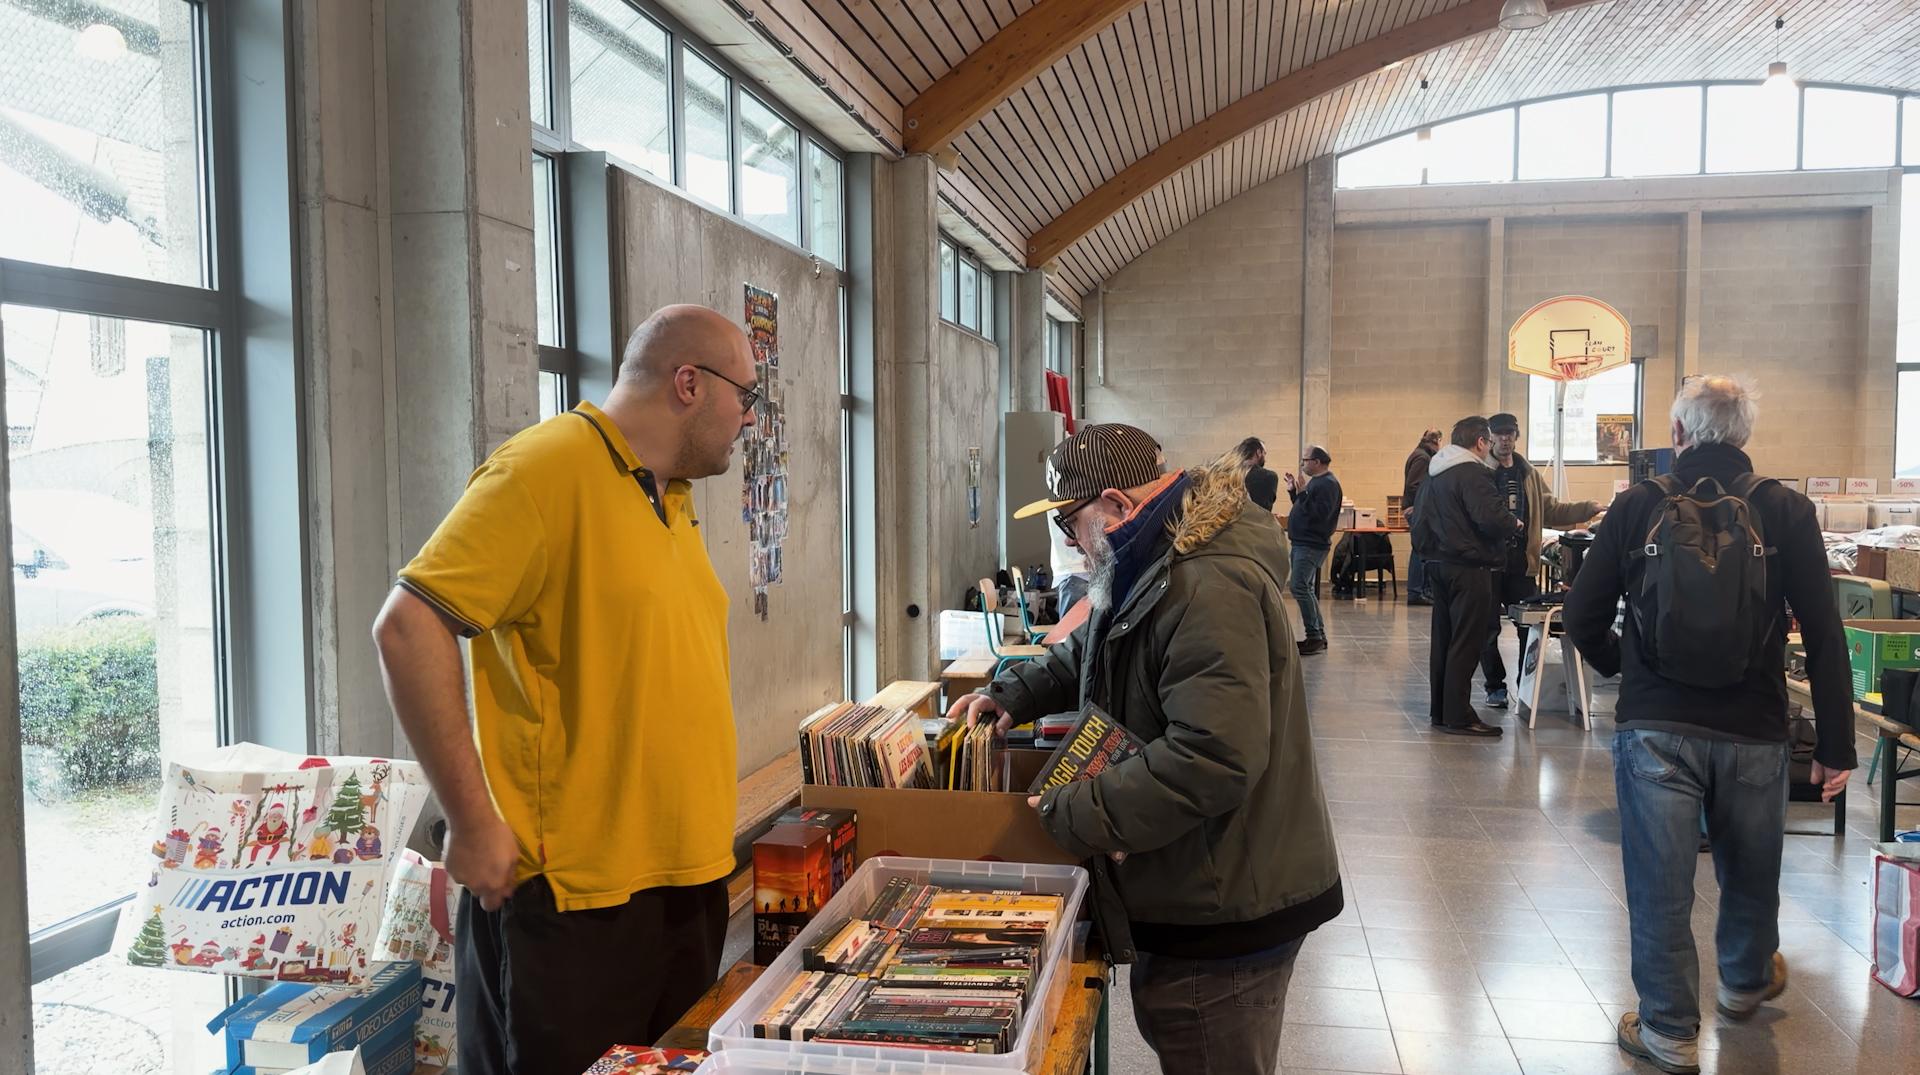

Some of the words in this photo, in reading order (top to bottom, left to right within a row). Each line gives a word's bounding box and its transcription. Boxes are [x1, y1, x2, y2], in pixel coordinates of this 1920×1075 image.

[1040, 757, 1079, 795] AGIC
[1068, 714, 1108, 760] TOUCH
[196, 871, 351, 913] ACTION
[221, 913, 295, 929] action.com
[355, 1017, 381, 1042] VIDEO
[382, 987, 421, 1022] CASSETTES
